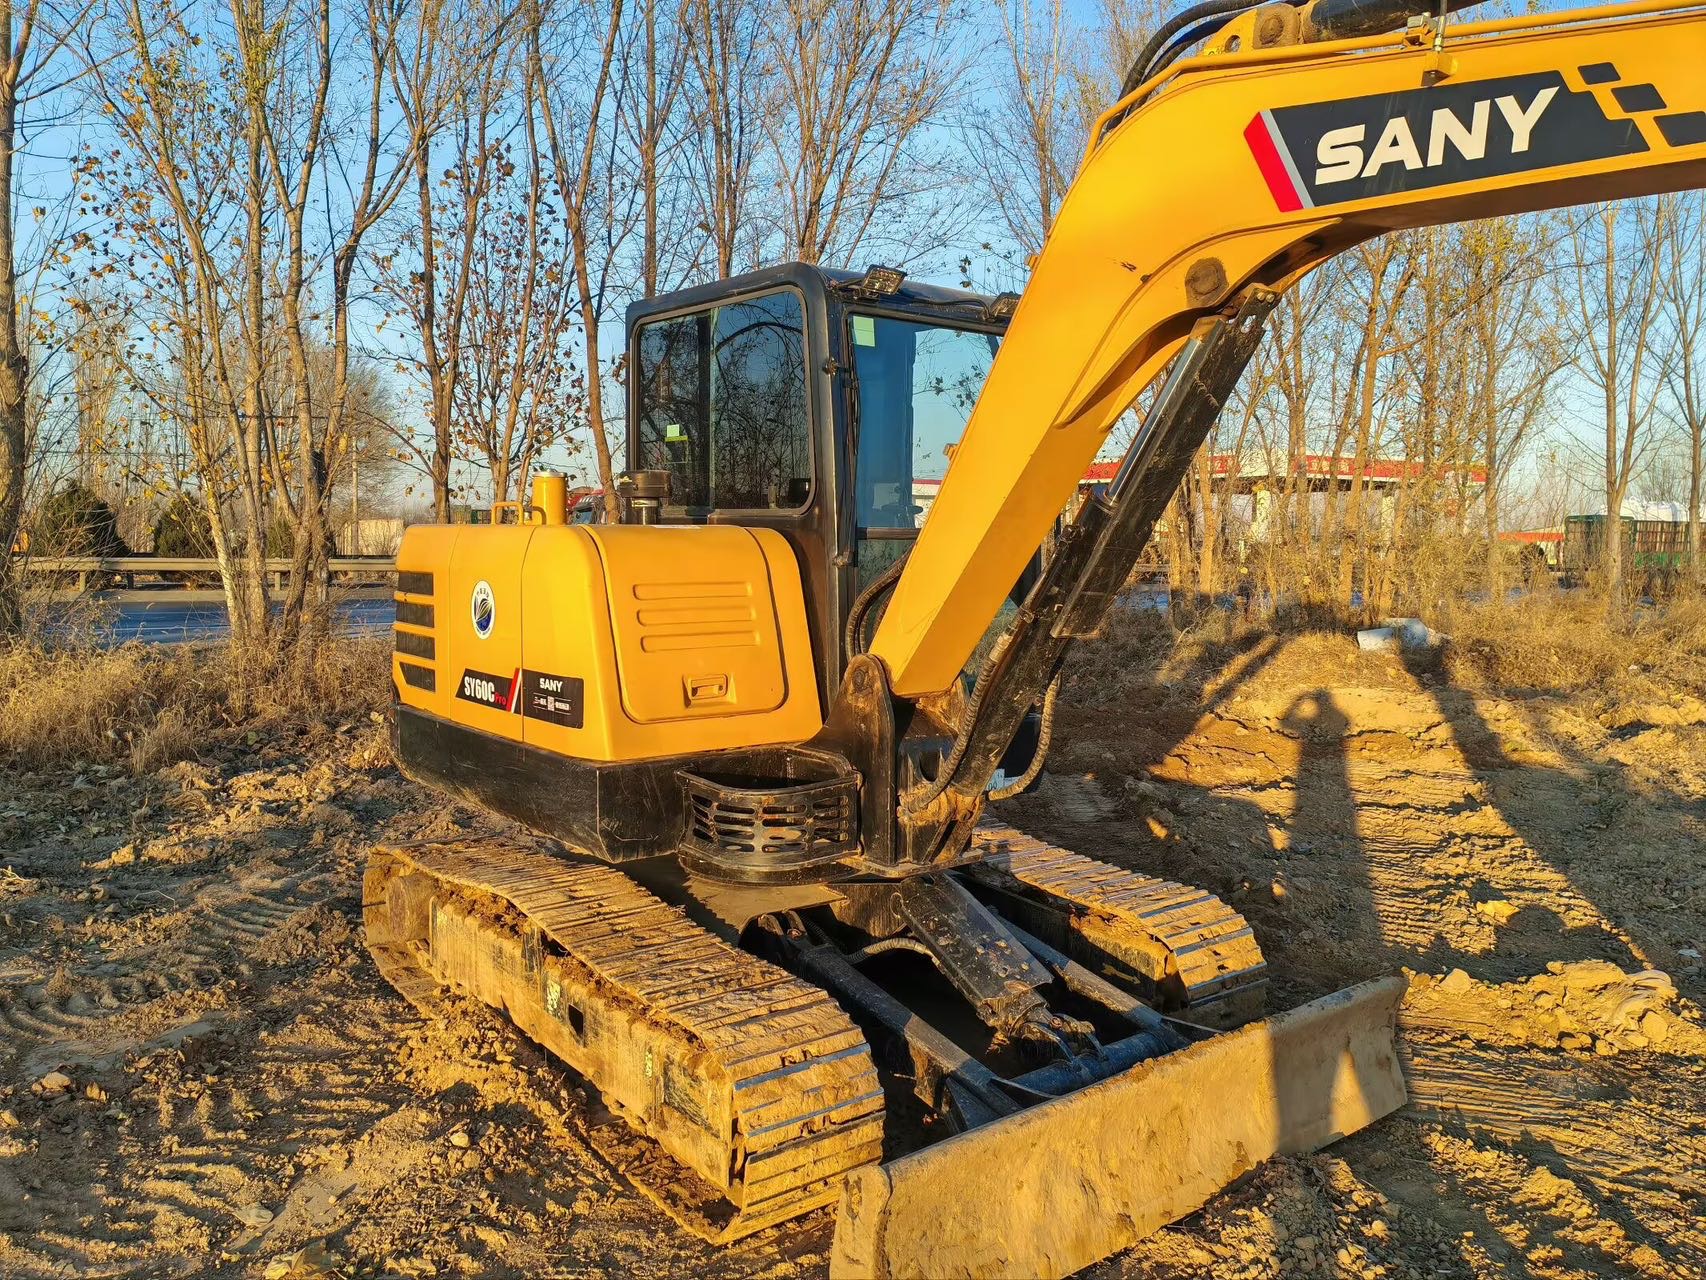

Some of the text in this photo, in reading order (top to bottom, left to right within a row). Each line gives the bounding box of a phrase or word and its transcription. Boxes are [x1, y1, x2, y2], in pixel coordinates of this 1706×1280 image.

[1315, 86, 1560, 185] SANY
[464, 676, 495, 703] SY60C
[539, 678, 563, 692] SANY
